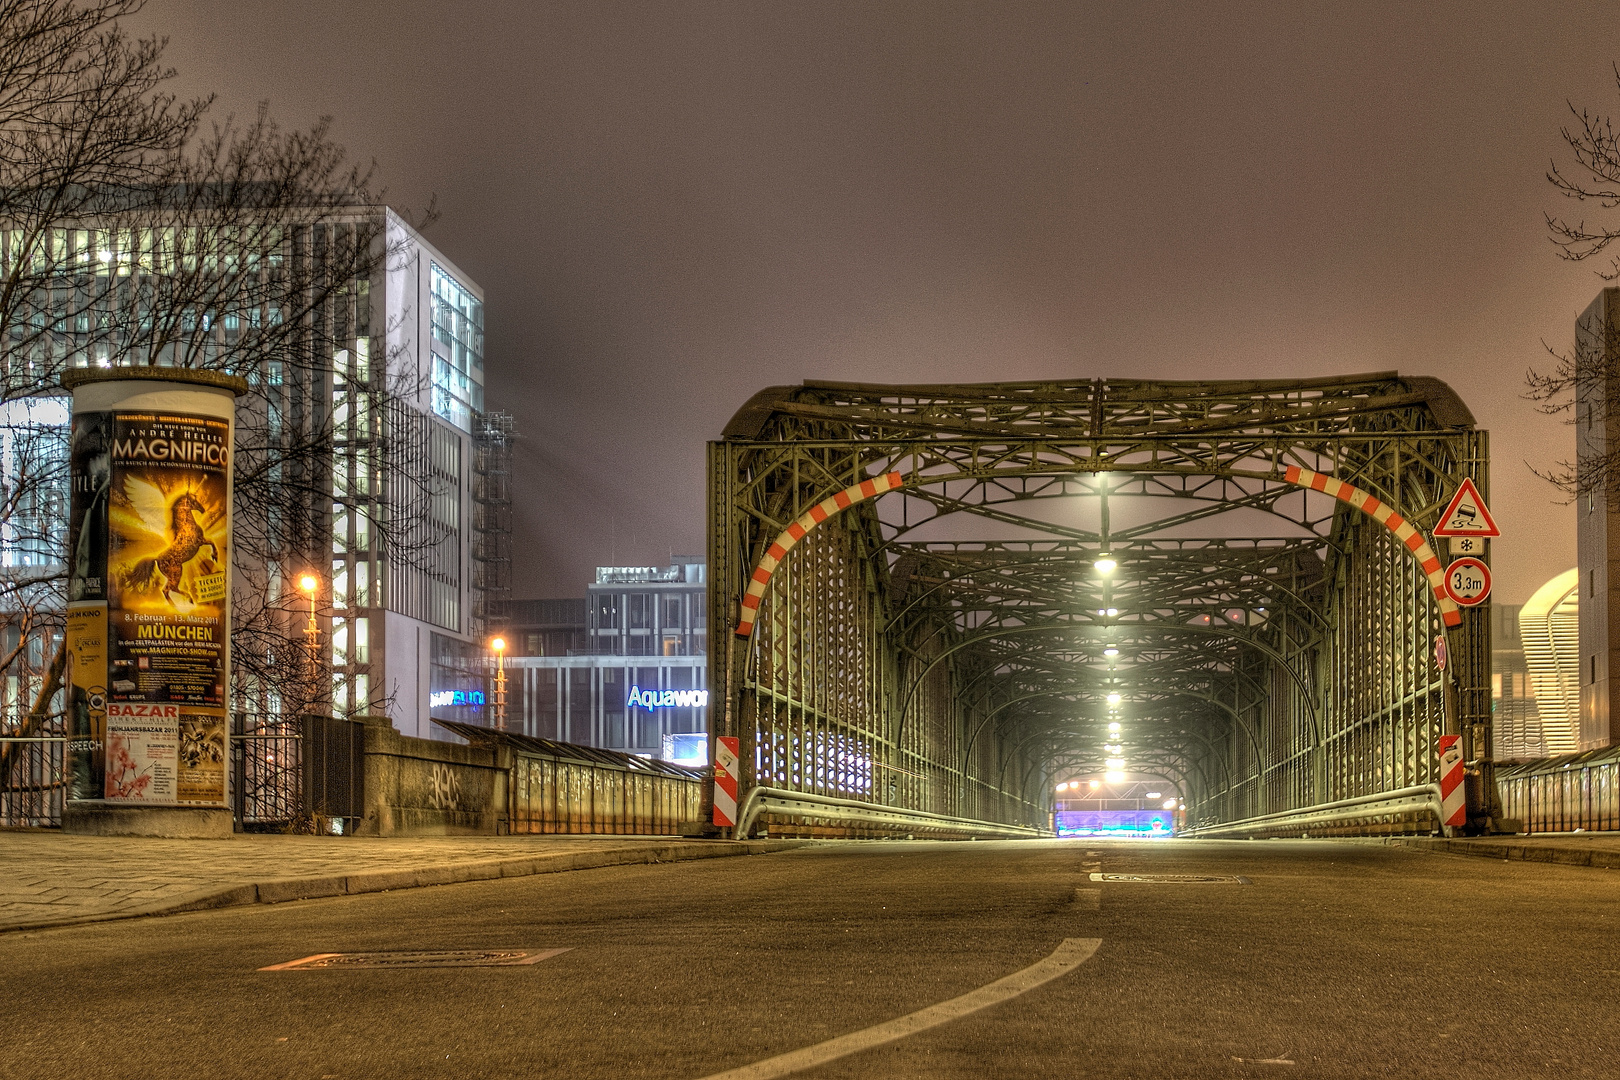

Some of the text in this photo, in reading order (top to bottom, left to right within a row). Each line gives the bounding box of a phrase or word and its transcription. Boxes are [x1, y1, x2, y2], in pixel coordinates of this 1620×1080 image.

[130, 429, 222, 442] ANDRÉ HELLER
[112, 438, 229, 466] MAGNIFICO
[199, 576, 223, 586] TICKETS
[82, 610, 101, 618] KINO
[124, 614, 132, 622] 8.
[134, 614, 166, 622] Februar
[174, 614, 185, 622] 13.
[204, 616, 218, 625] 2011
[138, 622, 212, 640] MÜNCHEN
[130, 647, 218, 656] www.MAGNIFICO-SHOW.com
[108, 704, 178, 718] BAZAR
